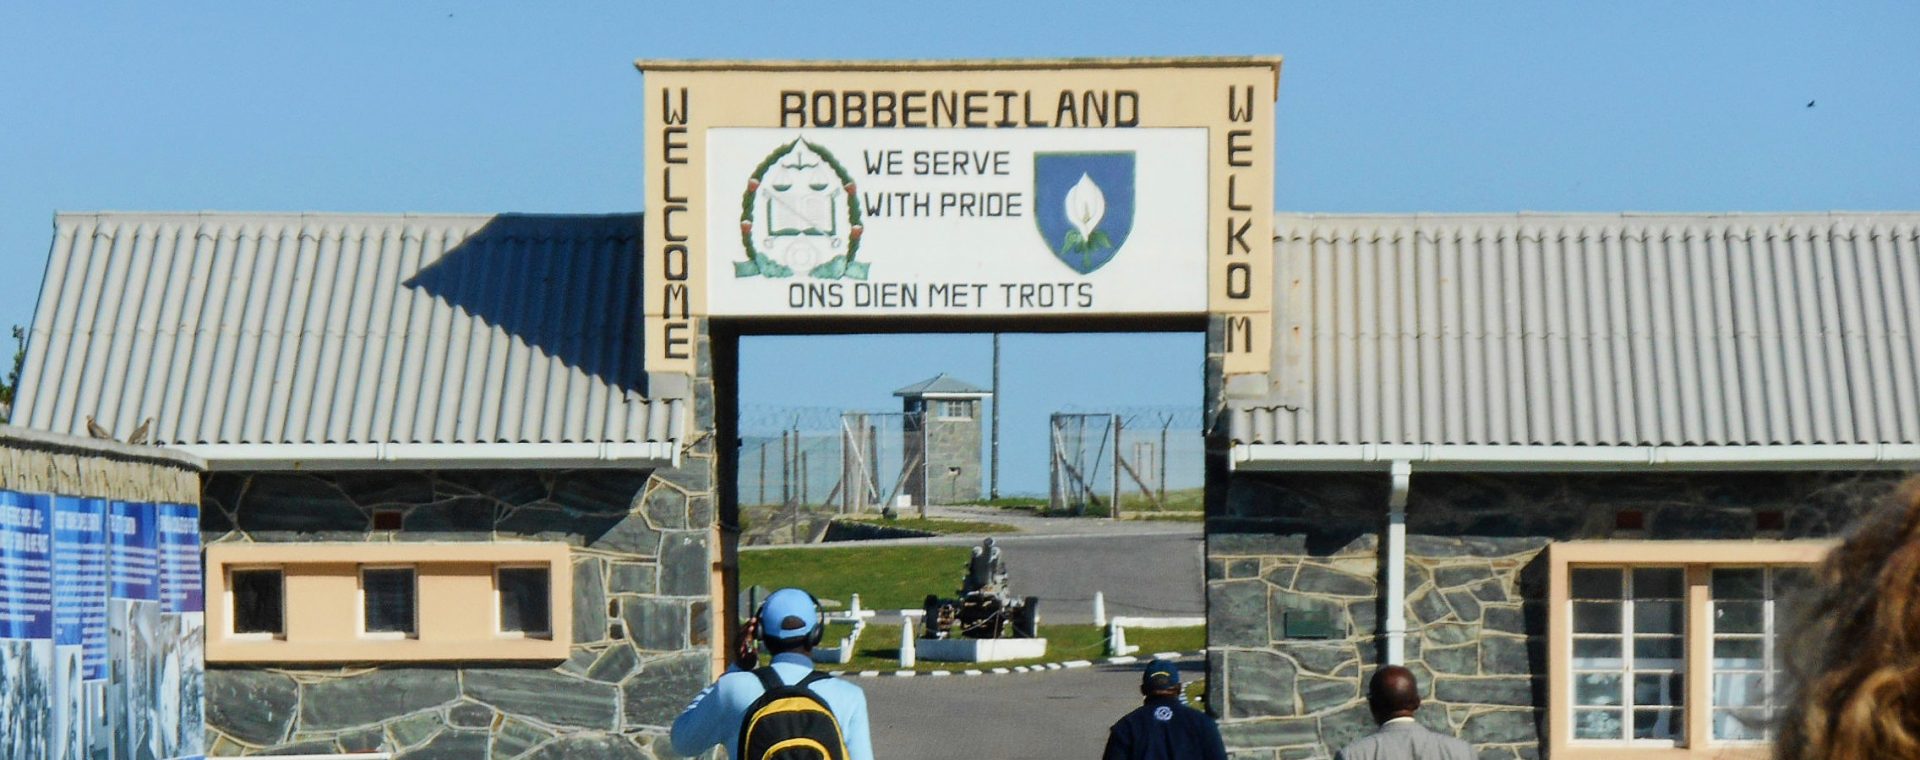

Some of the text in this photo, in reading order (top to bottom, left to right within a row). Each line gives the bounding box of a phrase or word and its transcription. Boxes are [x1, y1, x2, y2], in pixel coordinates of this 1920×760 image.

[781, 91, 1138, 128] ROBBENEILAND
[865, 150, 1009, 174] WE SERVE
[864, 192, 1021, 217] WITH PRIDE
[1226, 85, 1254, 354] WELKOM
[662, 88, 689, 360] WELCOME
[789, 283, 1092, 308] ONS DIEN MET TROTS
